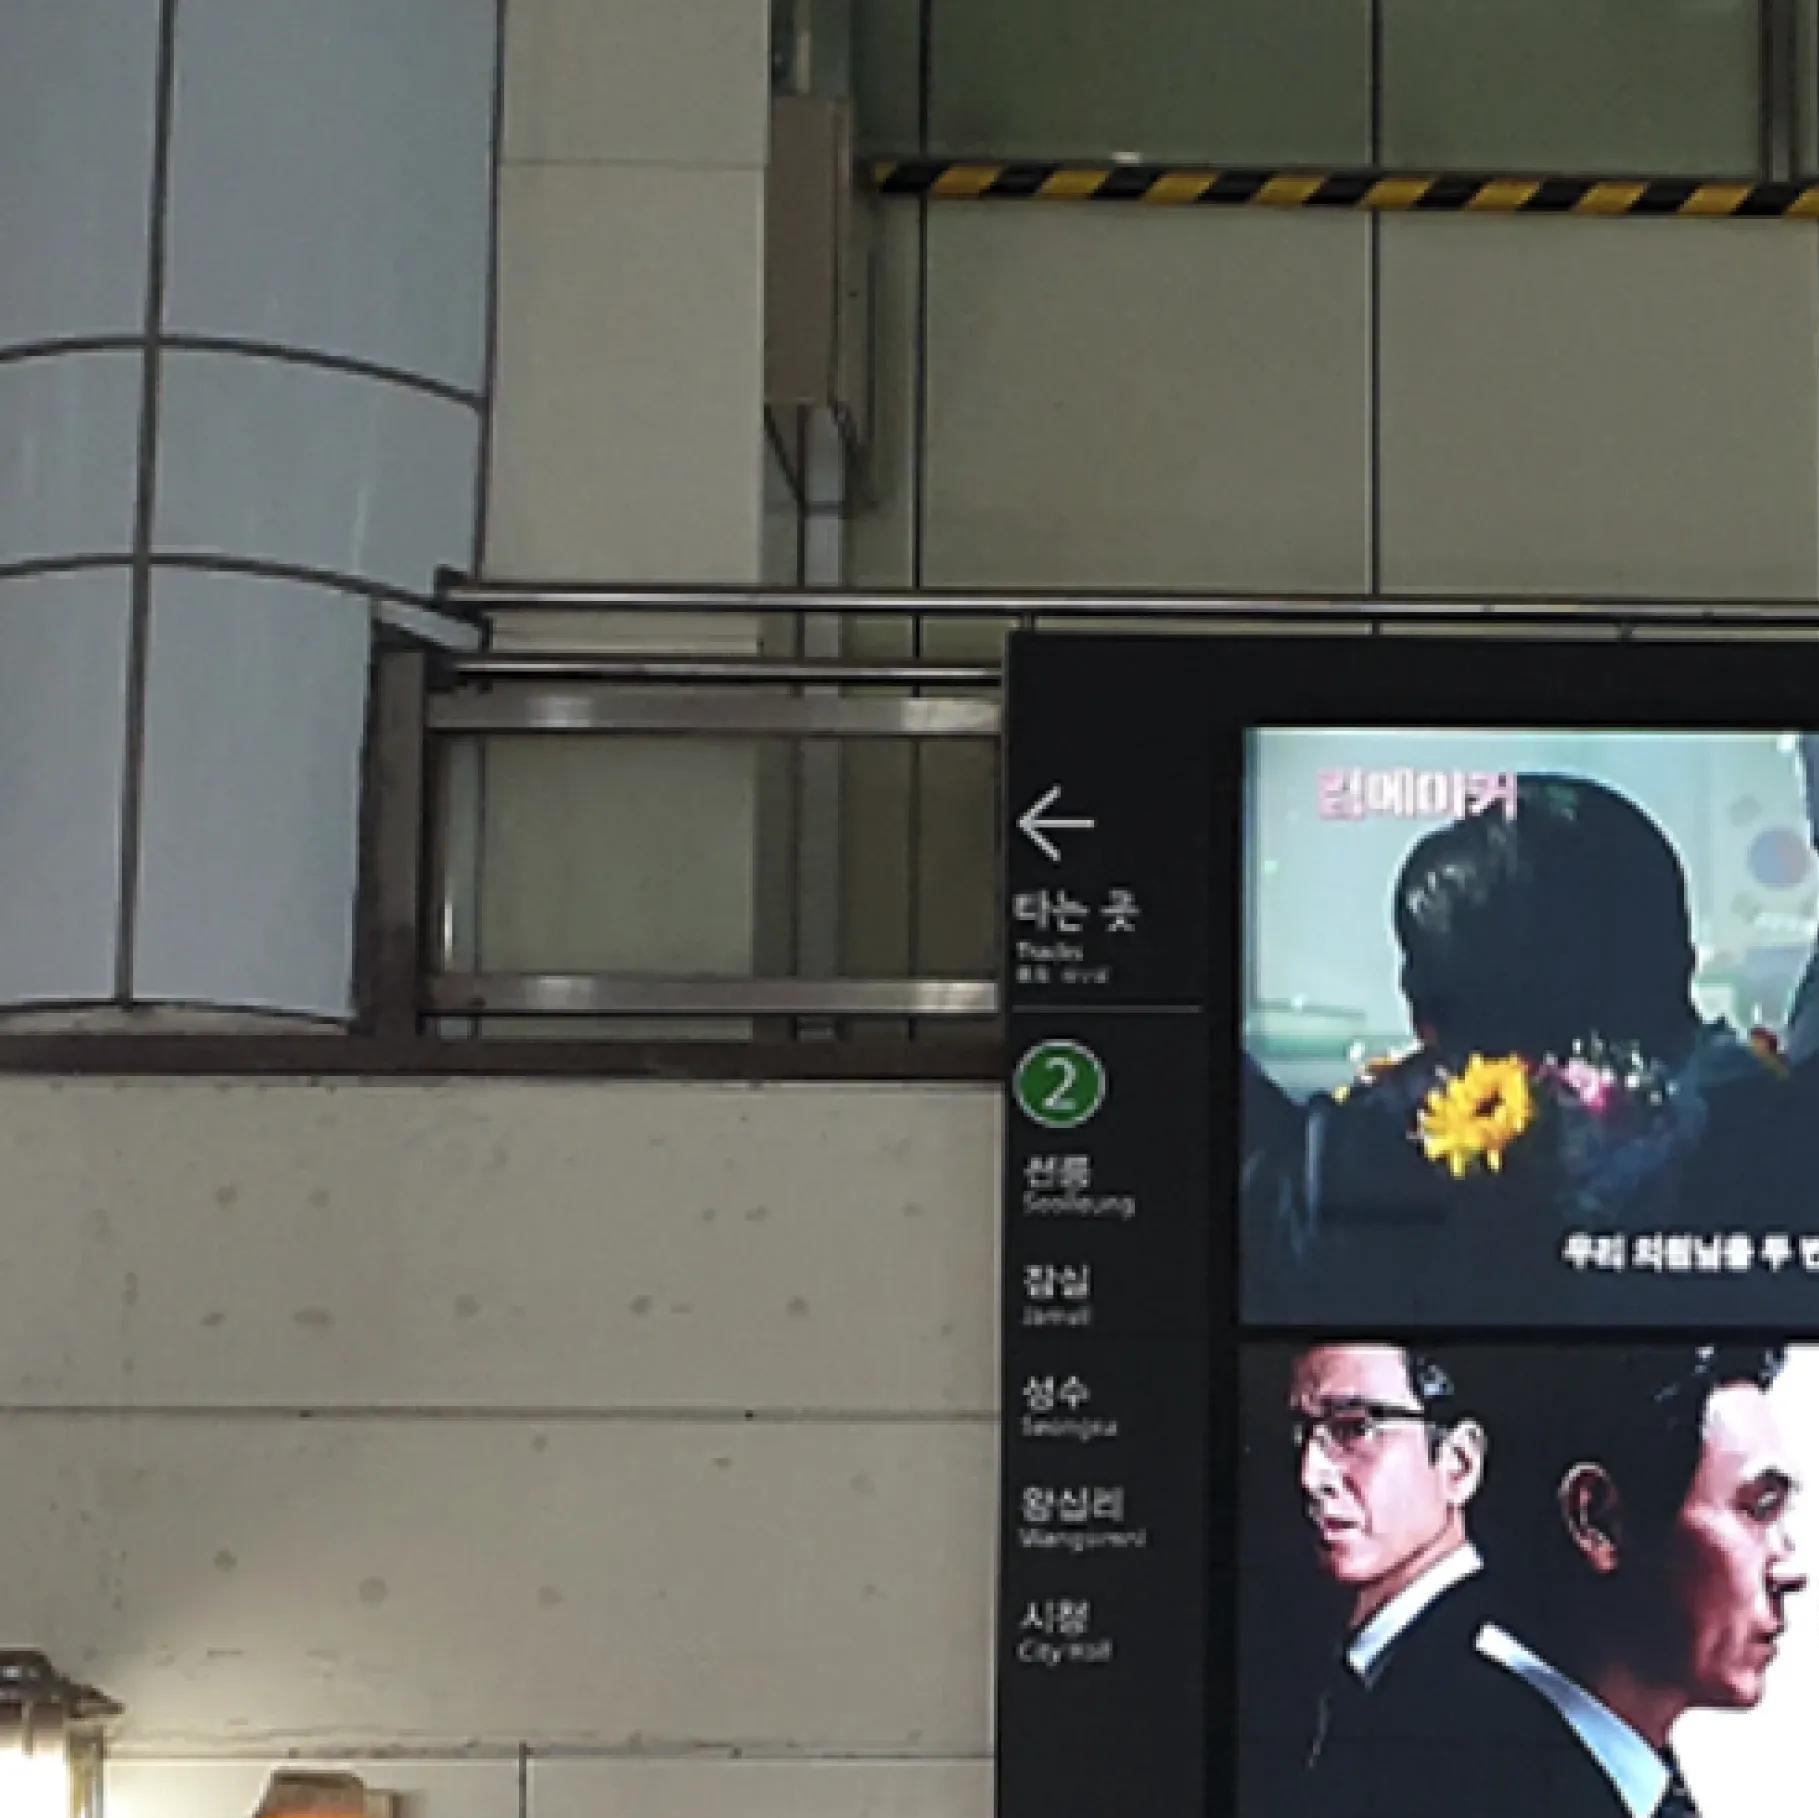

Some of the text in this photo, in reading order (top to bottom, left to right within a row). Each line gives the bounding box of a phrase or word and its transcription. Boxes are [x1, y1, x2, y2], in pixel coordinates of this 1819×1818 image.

[1318, 768, 1518, 821] 킹메이커
[1012, 887, 1140, 931] 타는 곳
[1563, 1232, 1625, 1273] 우리
[1761, 1232, 1795, 1273] 두
[1023, 1376, 1090, 1410] 성수
[1022, 1486, 1125, 1522] 왕십리
